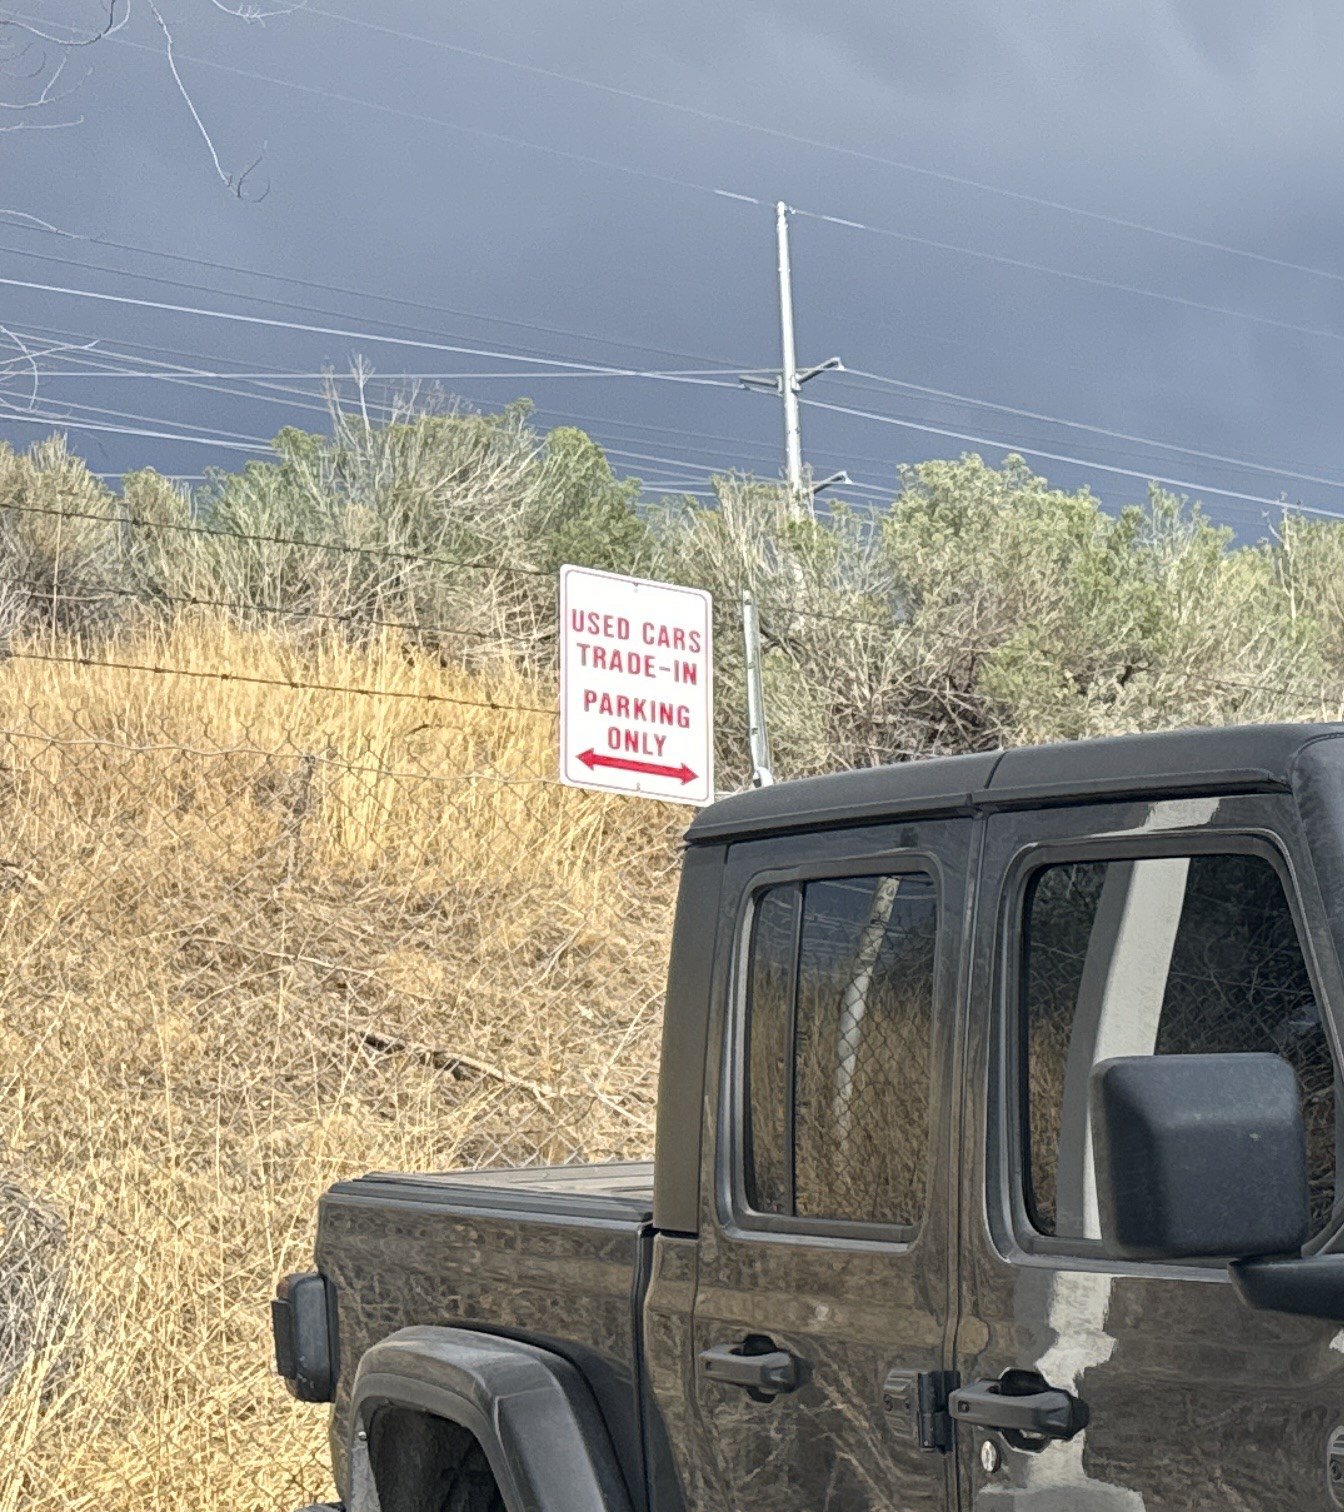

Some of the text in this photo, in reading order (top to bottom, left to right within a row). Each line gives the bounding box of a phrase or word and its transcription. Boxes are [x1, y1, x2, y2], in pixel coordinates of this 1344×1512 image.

[571, 609, 701, 654] USED CARS
[577, 643, 697, 685] TRADE-IN
[584, 689, 690, 728] PARKING
[607, 727, 666, 757] ONLY
